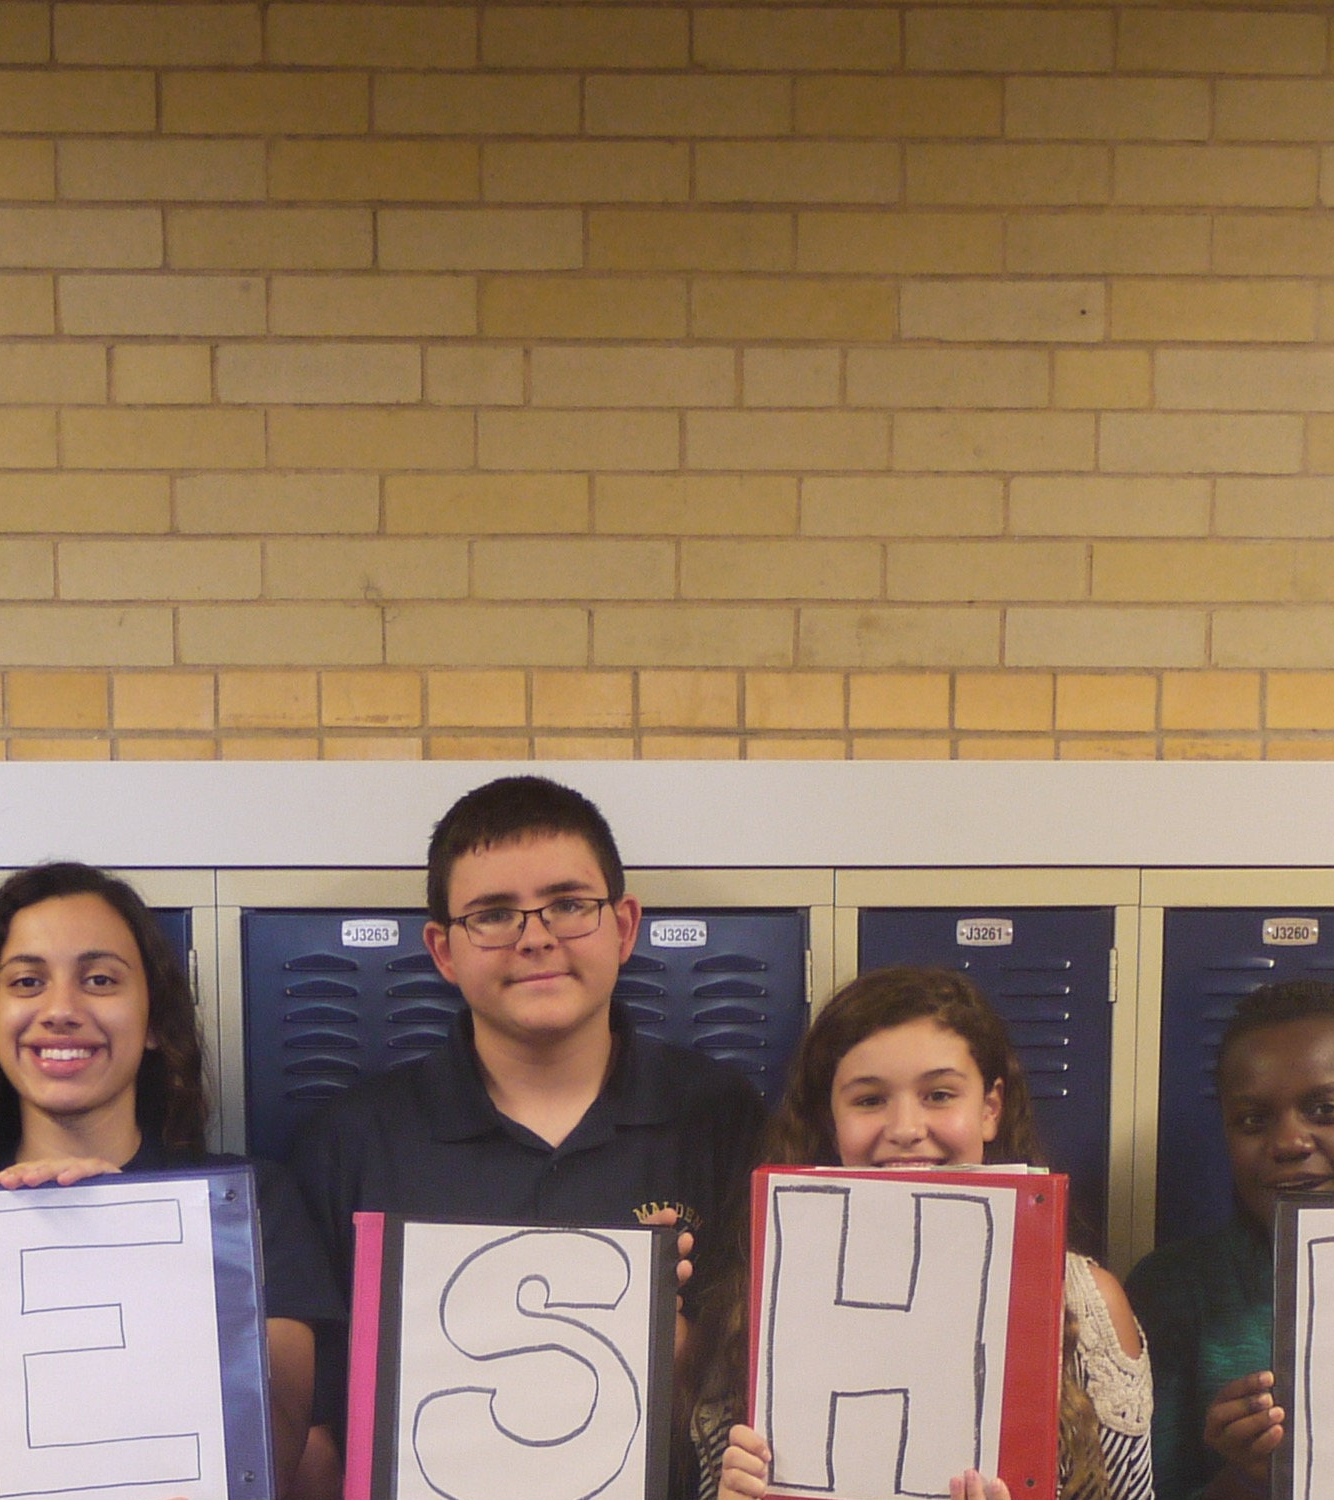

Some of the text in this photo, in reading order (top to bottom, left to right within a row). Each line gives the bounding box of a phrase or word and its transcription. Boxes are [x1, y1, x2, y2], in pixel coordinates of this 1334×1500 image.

[352, 928, 389, 941] J3263
[660, 928, 697, 942] J3262
[966, 927, 1003, 941] J3261
[1272, 926, 1309, 940] J3260
[764, 1184, 995, 1499] H
